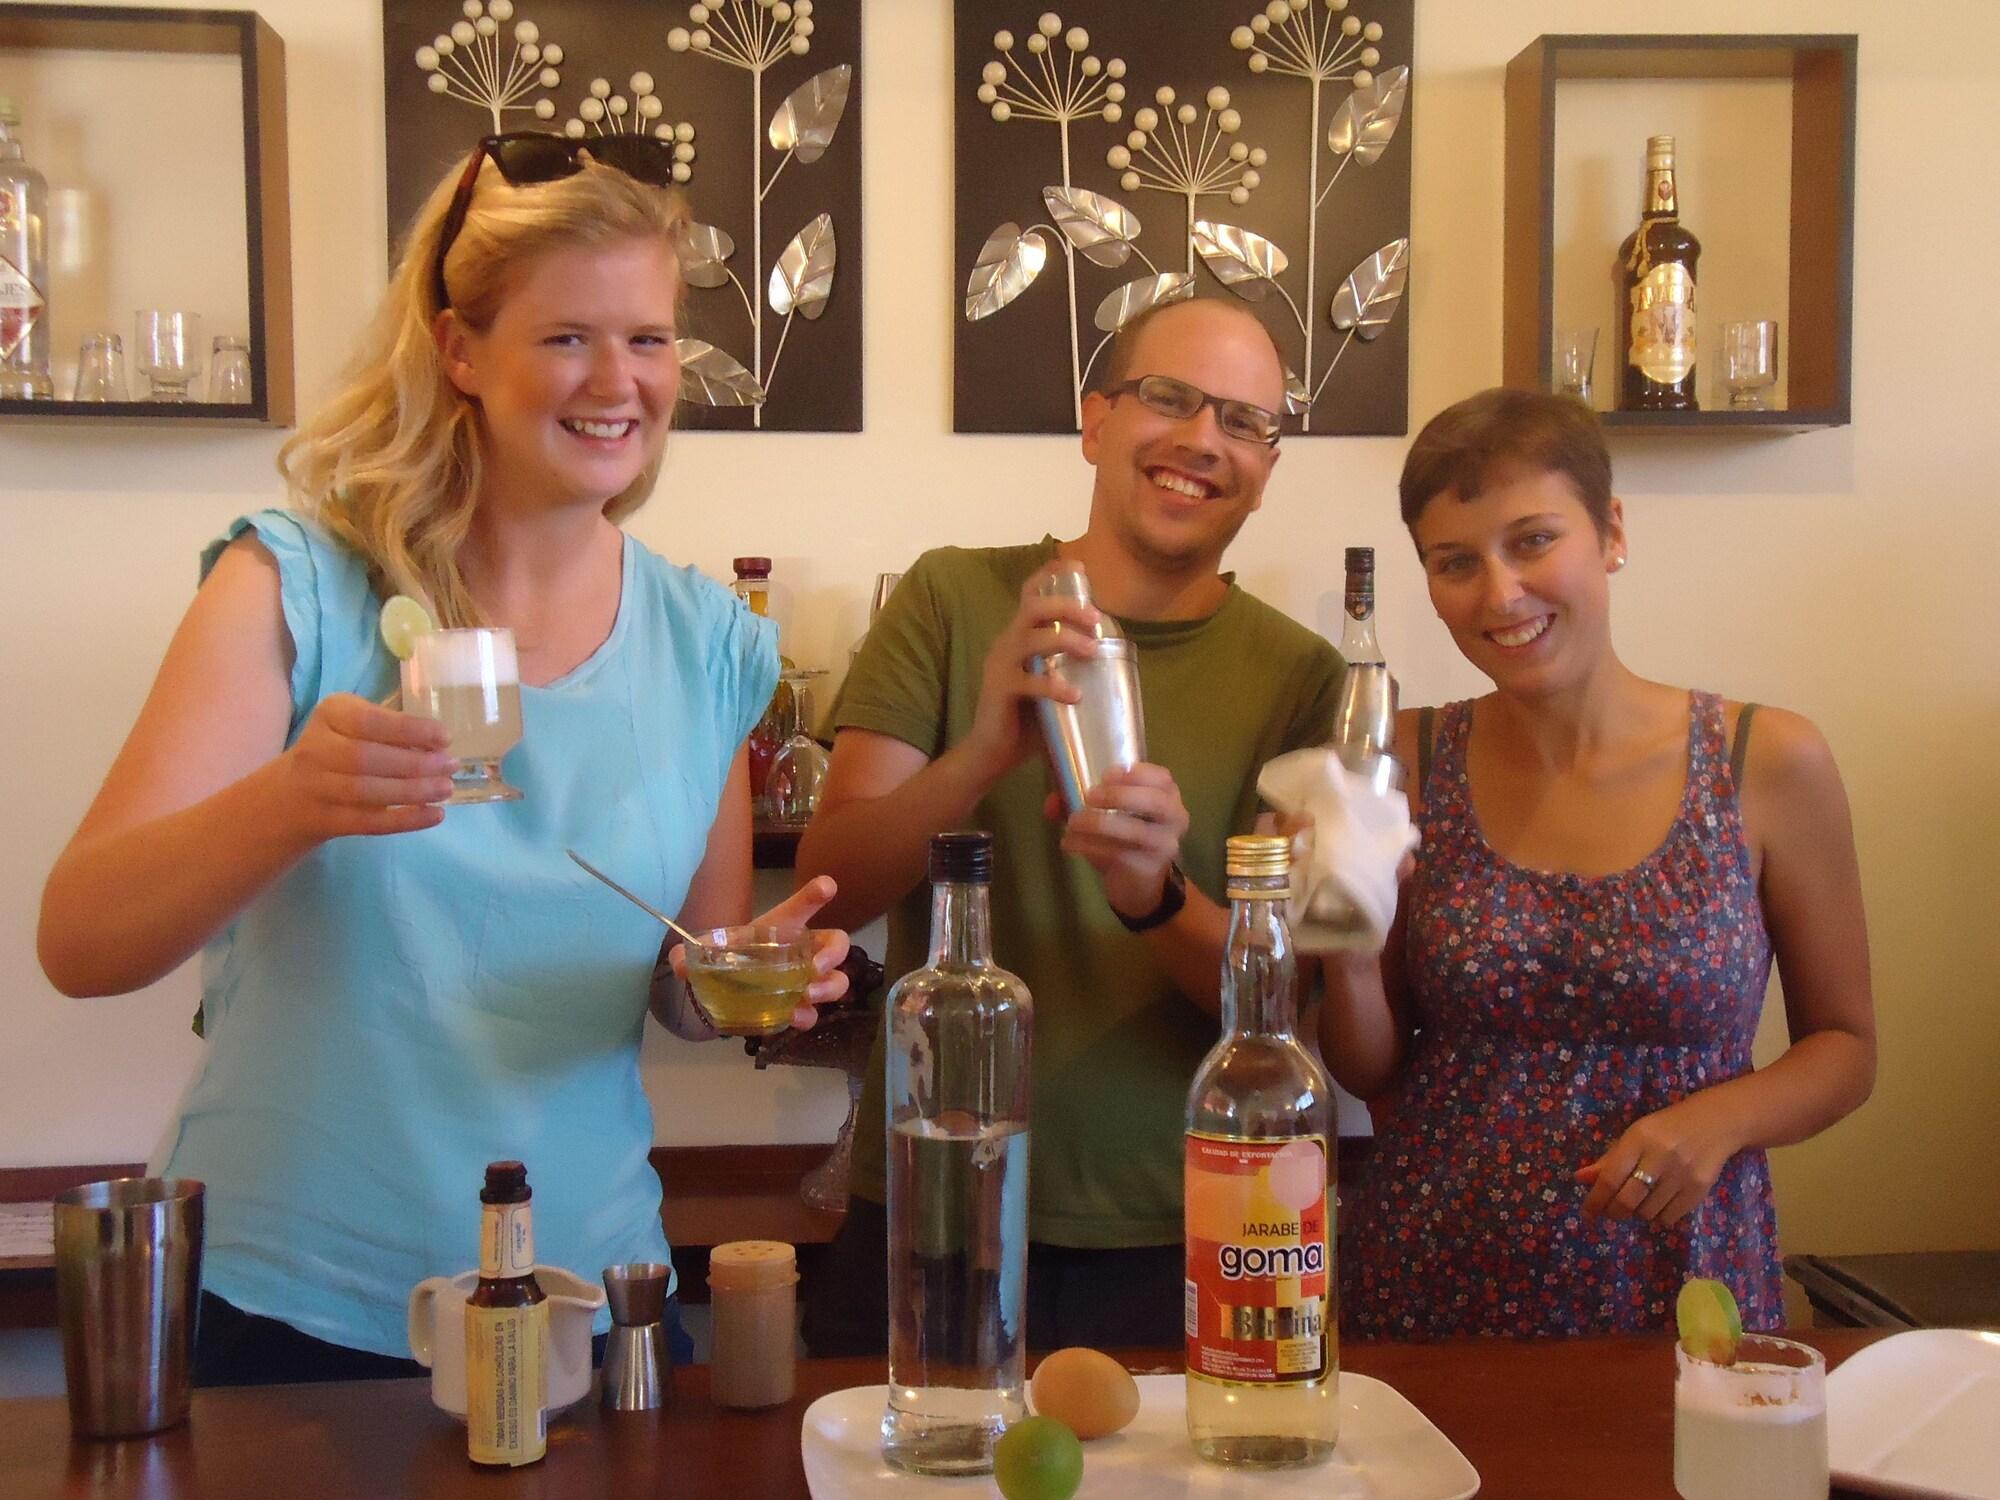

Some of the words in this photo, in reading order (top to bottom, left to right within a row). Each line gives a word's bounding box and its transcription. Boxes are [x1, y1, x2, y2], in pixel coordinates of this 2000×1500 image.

[1242, 1222, 1299, 1237] JARABE
[1302, 1220, 1319, 1234] DE
[1219, 1241, 1324, 1280] goma
